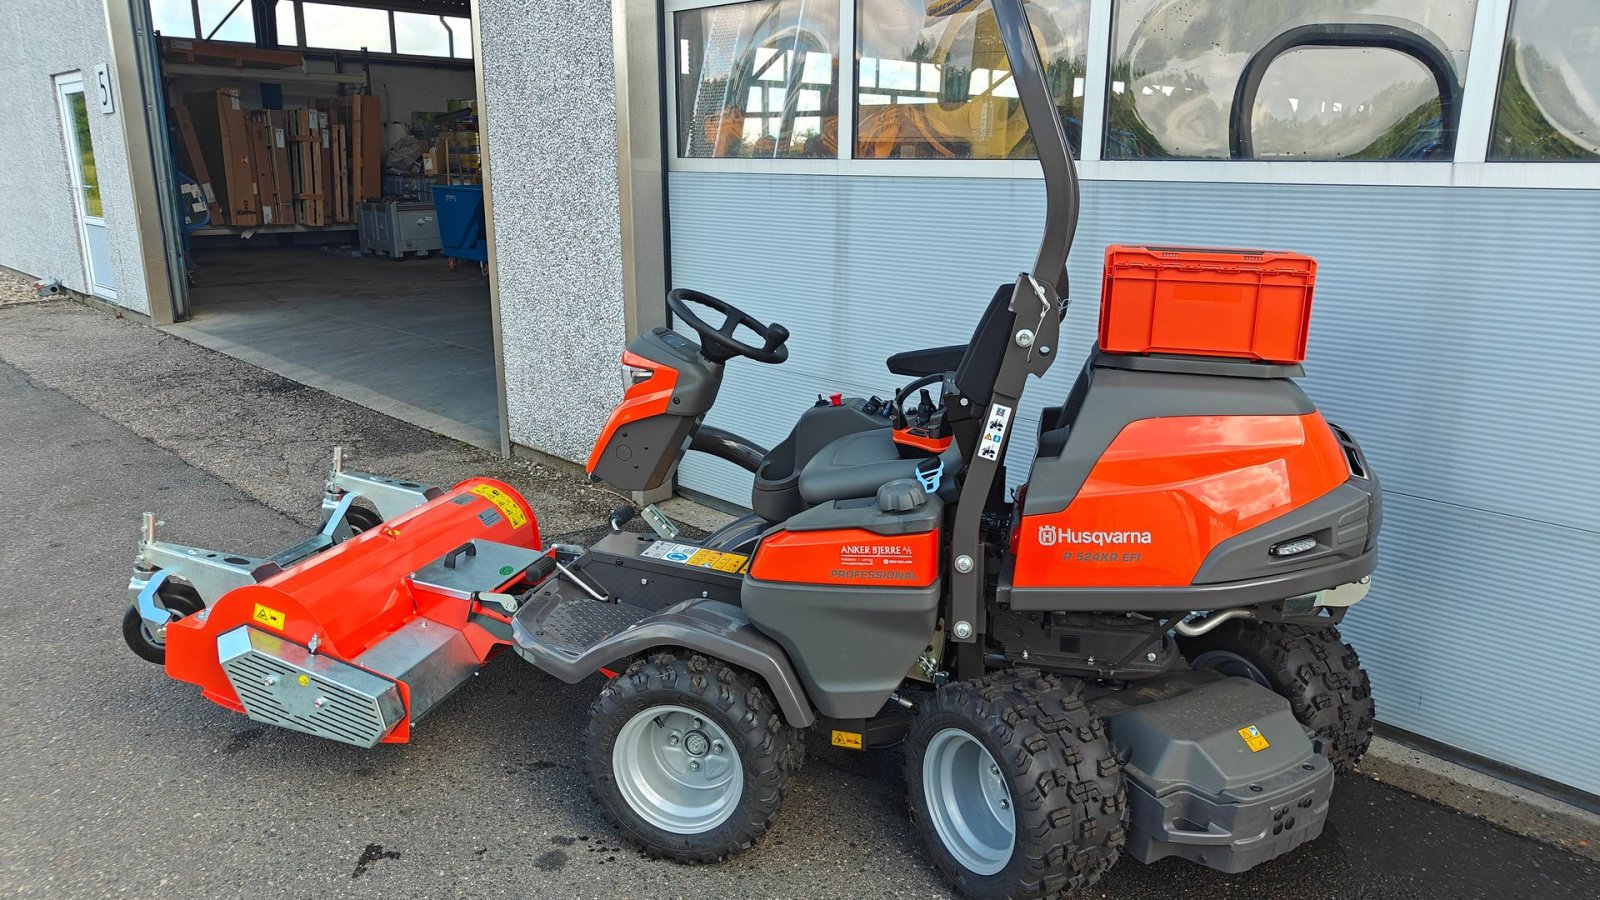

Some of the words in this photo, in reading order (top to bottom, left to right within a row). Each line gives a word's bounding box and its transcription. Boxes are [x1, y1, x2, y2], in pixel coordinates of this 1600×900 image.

[98, 71, 107, 106] 5
[1058, 528, 1151, 546] Husqvarna
[841, 546, 870, 554] ANKER
[872, 546, 901, 556] BJERRE
[1063, 552, 1073, 561] P
[1076, 552, 1119, 562] 524XR
[1122, 552, 1142, 562] EFI
[831, 570, 916, 580] PROFESSIONAL
